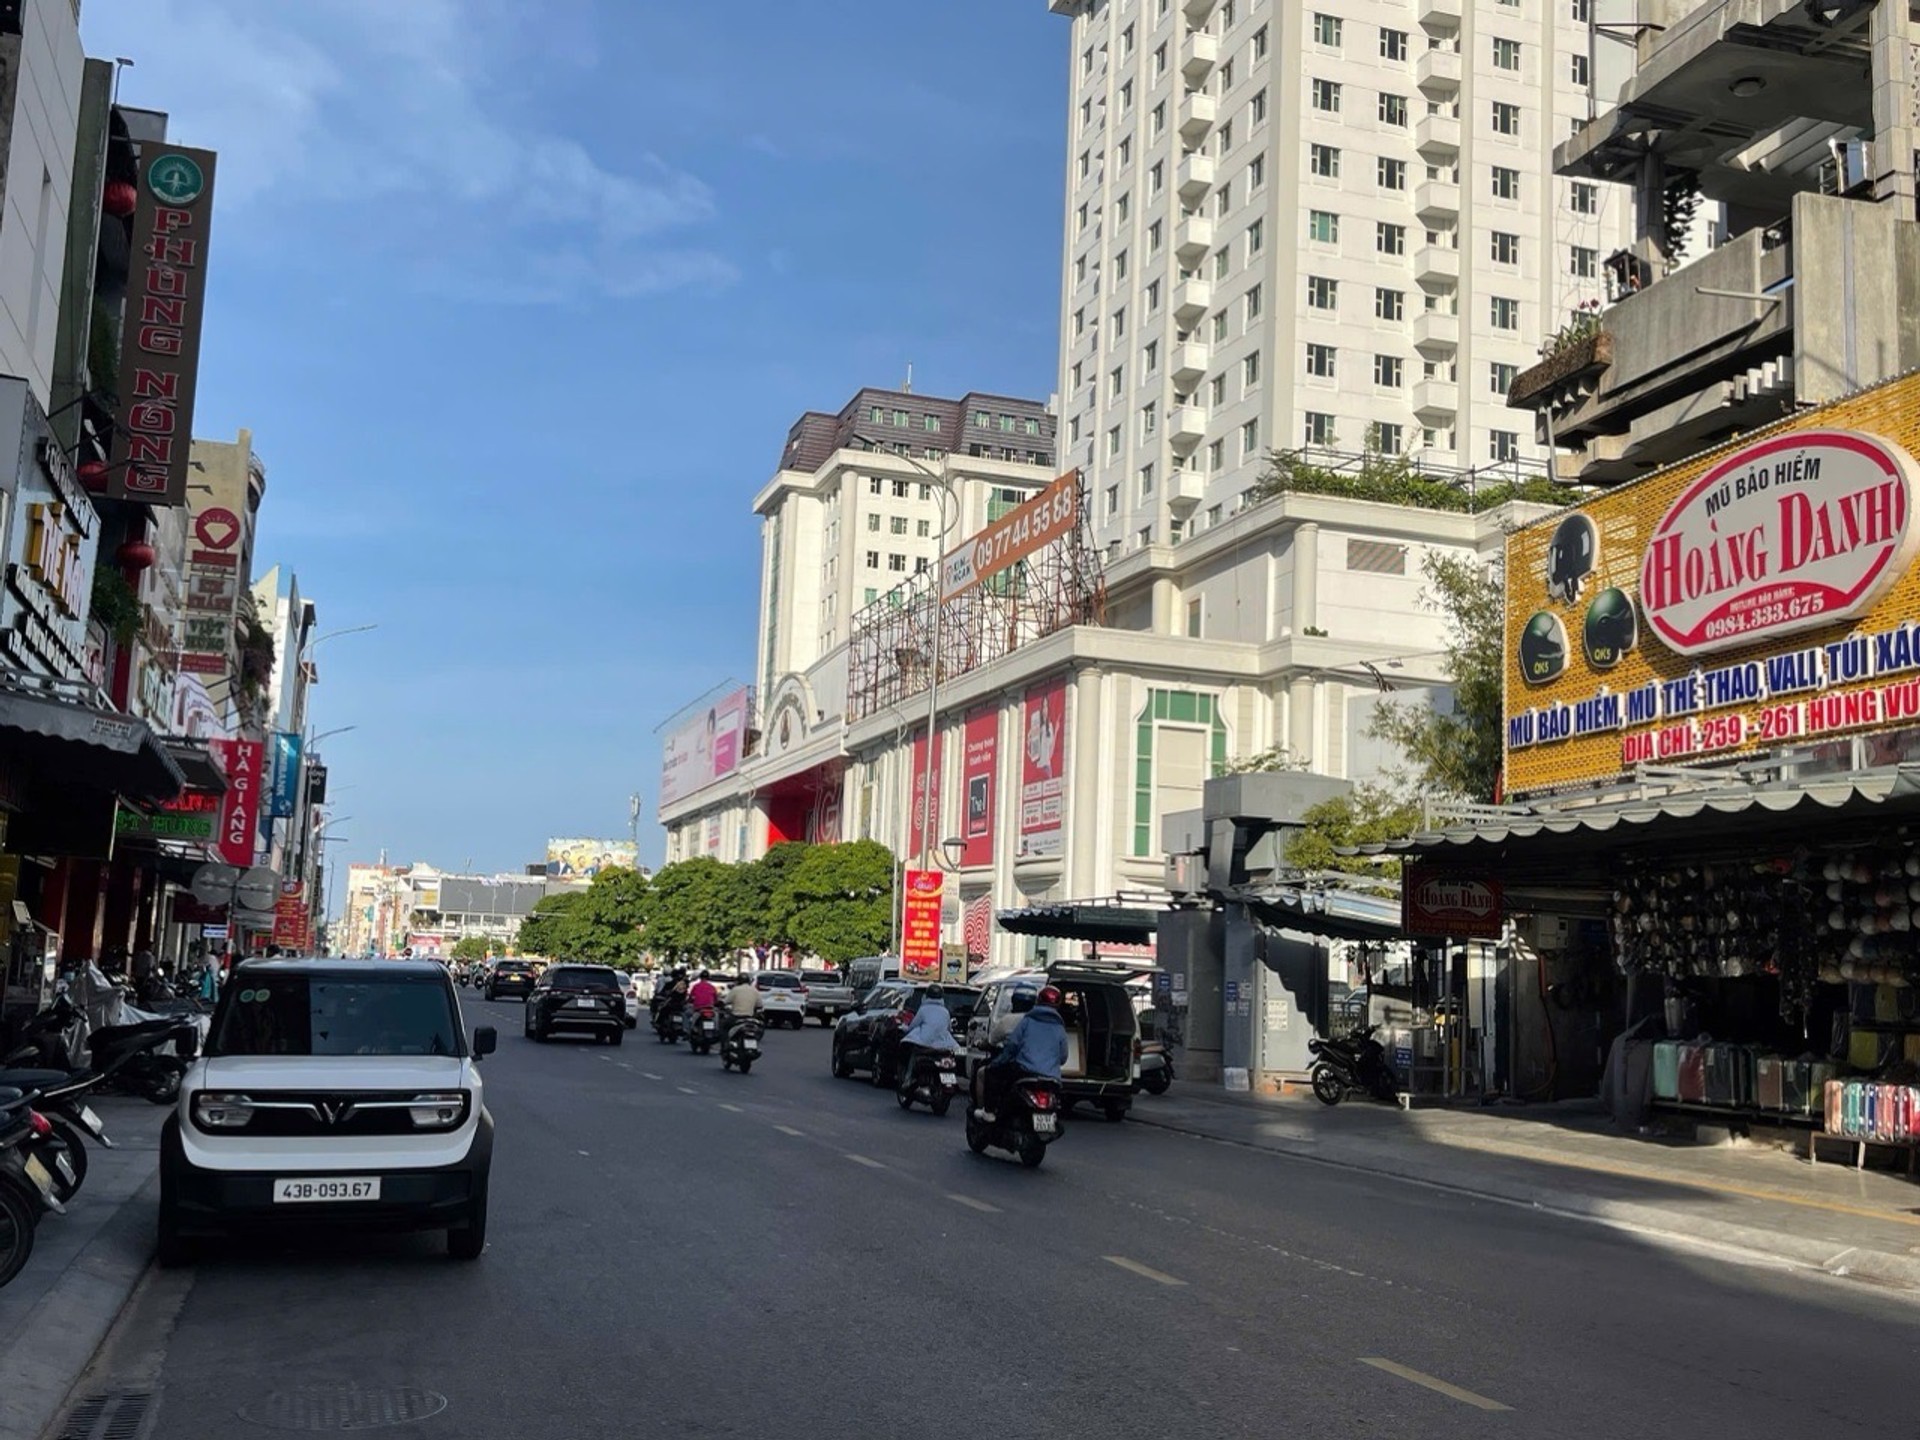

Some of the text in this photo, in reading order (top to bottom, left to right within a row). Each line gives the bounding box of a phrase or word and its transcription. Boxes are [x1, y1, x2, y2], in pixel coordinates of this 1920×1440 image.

[1705, 449, 1821, 518] MŨ BẢO HIỂM
[1652, 481, 1895, 612] HOÀNG DANH
[1705, 591, 1824, 639] 0984.333.675
[1509, 711, 1534, 747] MŨ
[1538, 704, 1570, 742] BẢO
[1576, 693, 1623, 733] HIỂM,
[1628, 683, 1657, 722] MŨ
[1705, 663, 1764, 706] THAO,
[1767, 648, 1824, 692] VALI,
[1826, 633, 1869, 682] TÚI
[1703, 714, 1742, 749] 259
[1761, 704, 1799, 740] 261
[1809, 690, 1877, 732] HÙNG
[229, 744, 252, 844] HÀ GIANG
